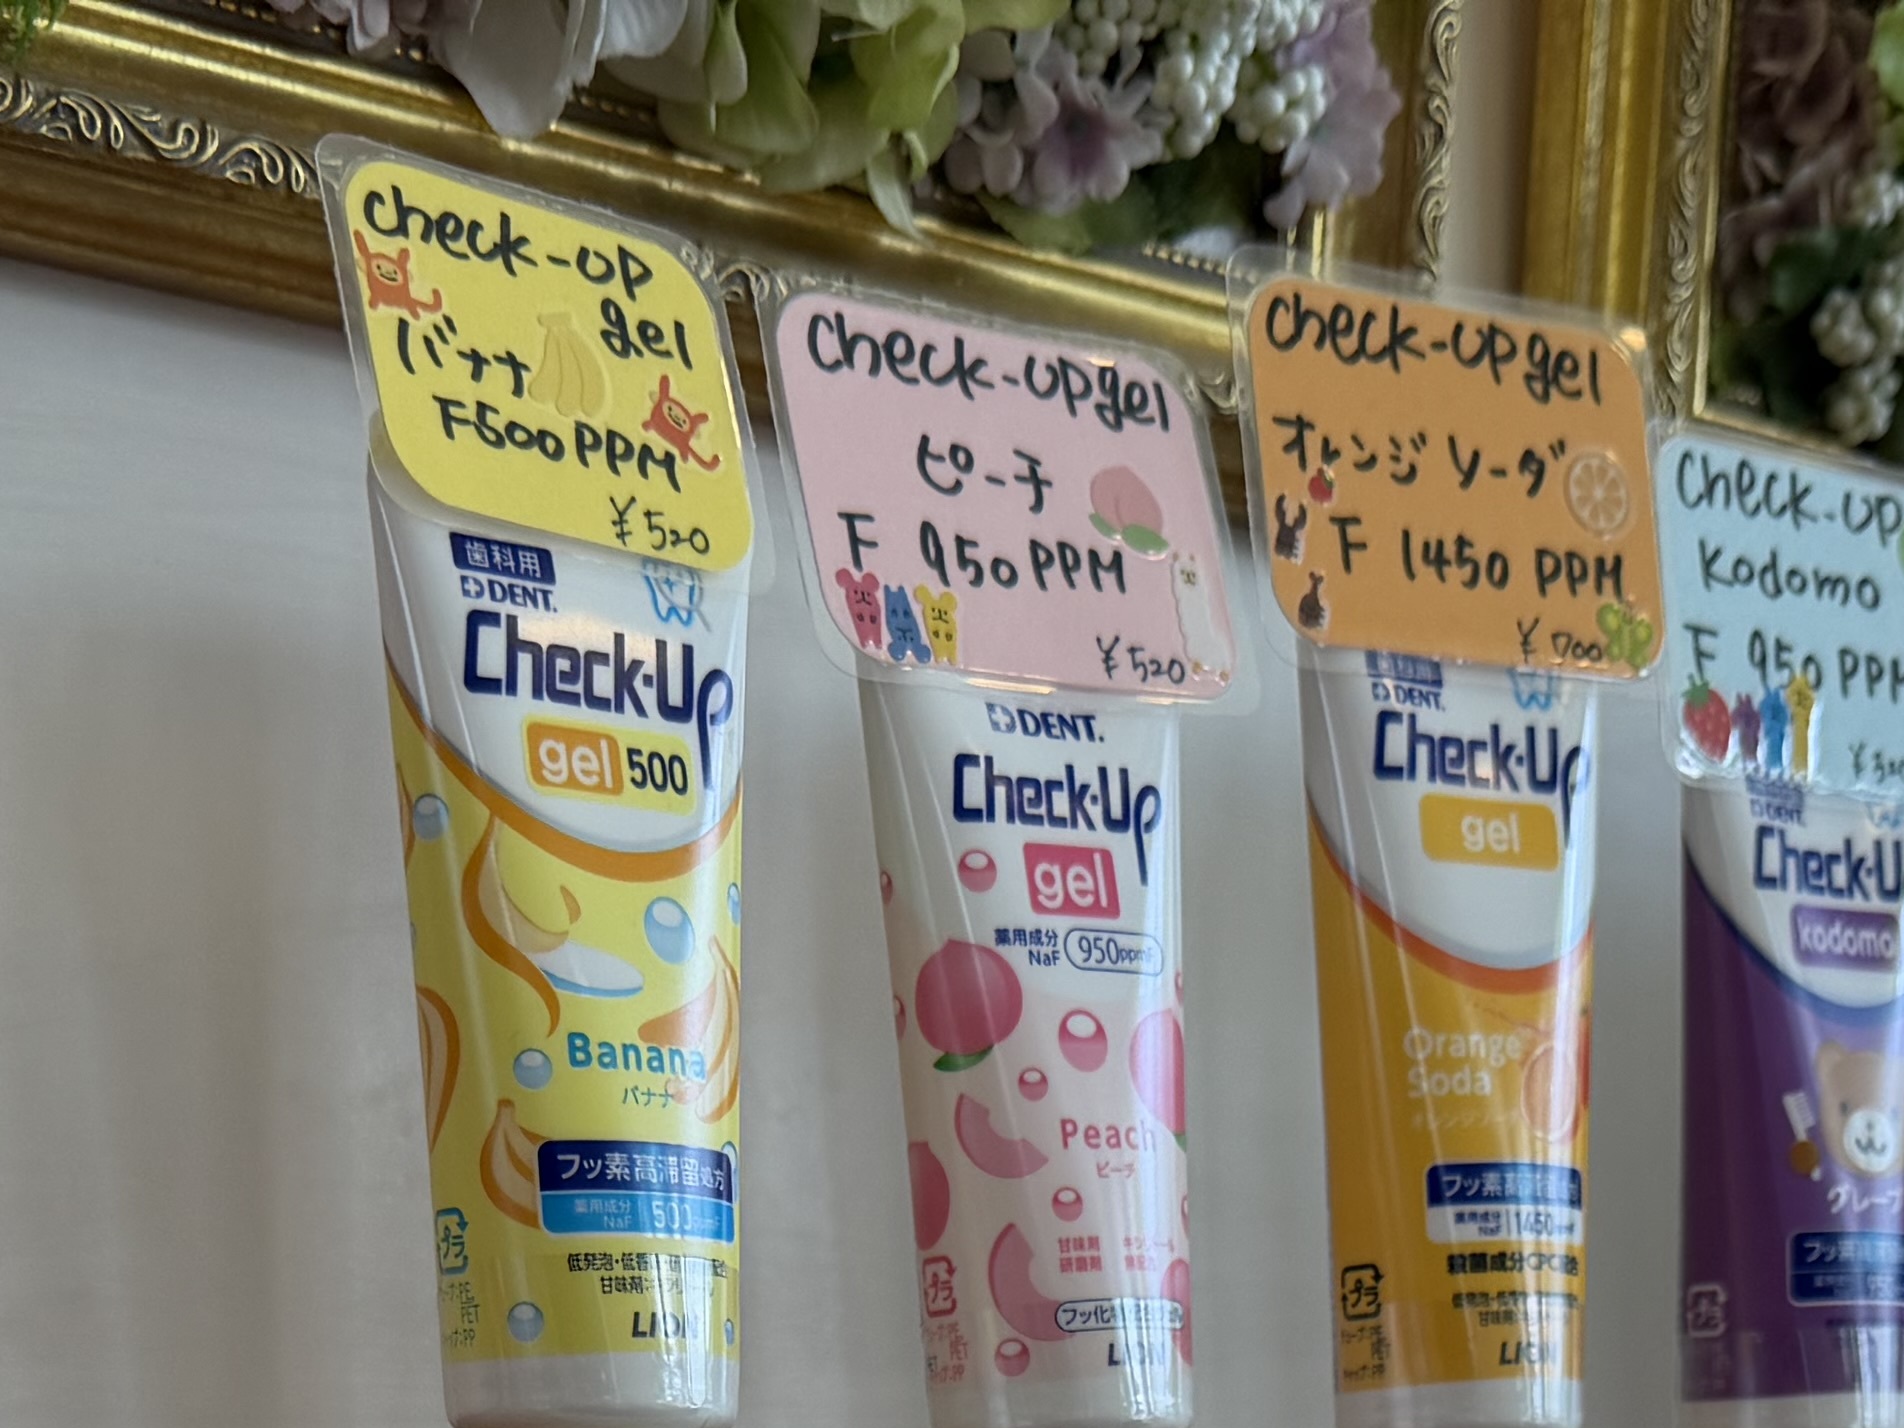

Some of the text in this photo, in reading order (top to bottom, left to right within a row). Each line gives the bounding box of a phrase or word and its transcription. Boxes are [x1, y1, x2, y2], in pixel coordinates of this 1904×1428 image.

[599, 297, 693, 370] gel
[462, 540, 542, 578] 歯科用
[1401, 528, 1510, 592] 1450
[538, 735, 689, 797] gel 500
[1459, 812, 1522, 855] gel
[1034, 850, 1110, 910] gel
[993, 928, 1059, 949] 薬用成分
[1028, 948, 1062, 967] NaF
[1798, 920, 1895, 960] kodomo
[566, 1031, 708, 1082] Banana
[1402, 1024, 1523, 1067] Orange
[621, 1086, 675, 1109] バナナ
[1408, 1065, 1494, 1098] Soda
[555, 1152, 726, 1192] フッ素高滞留処方
